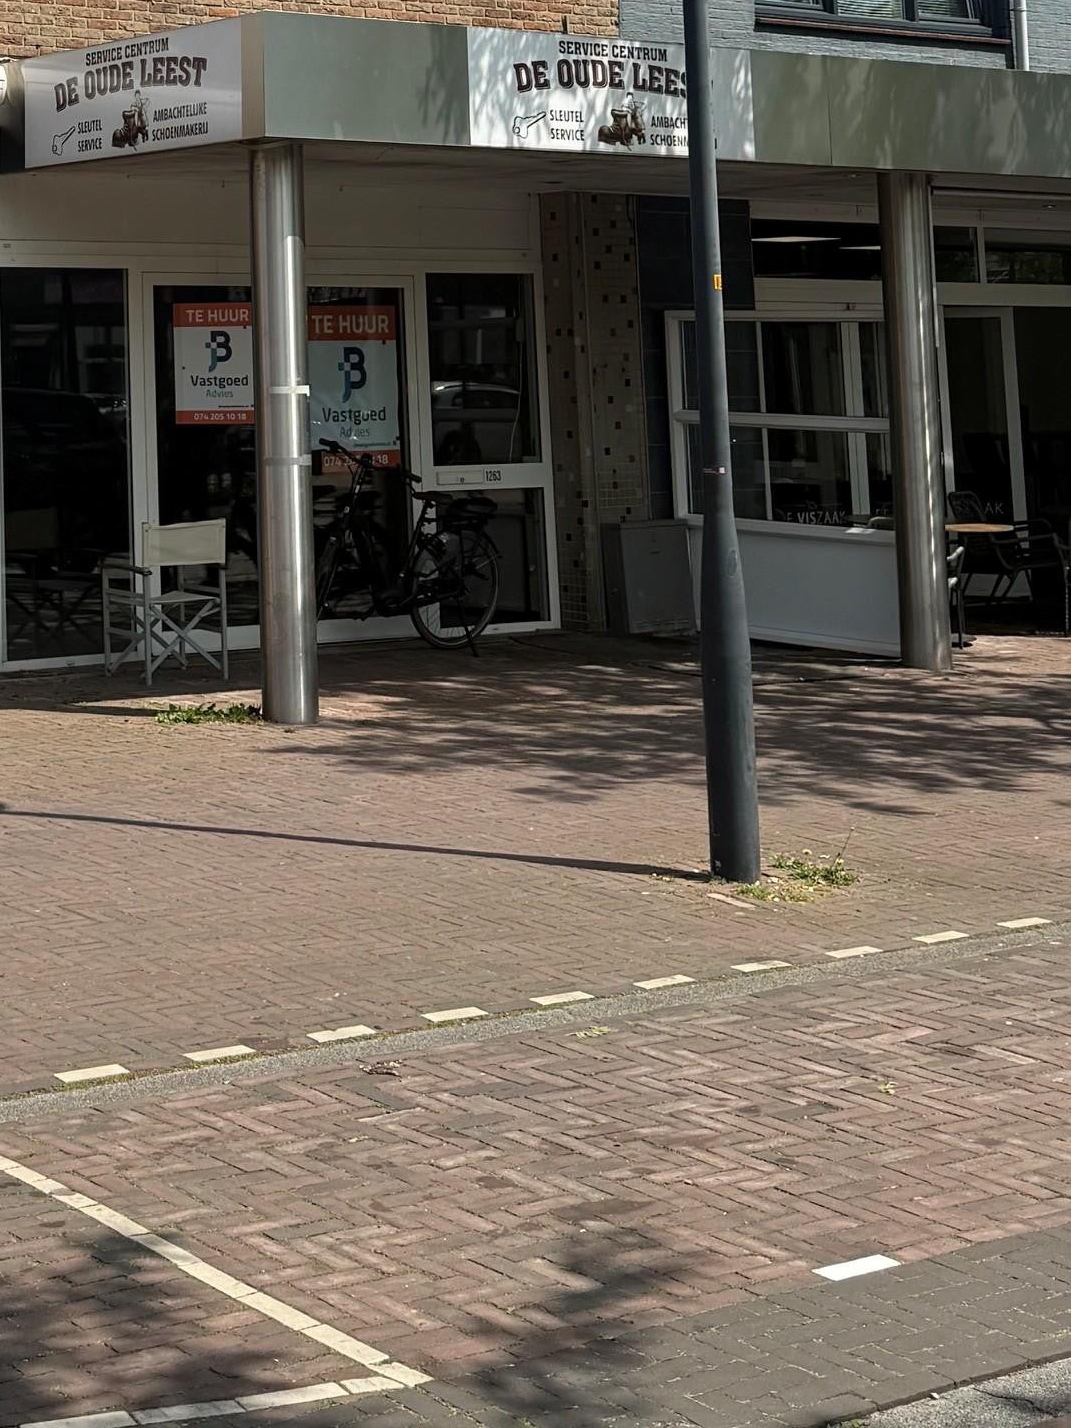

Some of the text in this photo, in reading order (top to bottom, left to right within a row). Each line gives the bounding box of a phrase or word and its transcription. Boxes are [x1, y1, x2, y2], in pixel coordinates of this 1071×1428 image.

[85, 37, 169, 66] SERVICE CENTRUM
[558, 40, 668, 62] SERVICE CENTRUM
[513, 60, 551, 93] DE
[556, 58, 626, 91] OUDE
[54, 56, 208, 112] DE OUDE LEEST
[153, 102, 208, 123] AMBACHTELIJKE
[549, 109, 585, 123] SLEUTEL
[77, 119, 103, 134] SLEUTEL
[152, 121, 209, 141] SCHOENMAKERIJ
[550, 128, 585, 142] SERVICE
[77, 137, 103, 153] SERVICE
[186, 308, 249, 323] TE HUUR
[311, 315, 389, 334] TE HUUR
[190, 375, 249, 388] Vastgoed
[205, 389, 234, 398] Advies
[322, 406, 386, 425] Vastgoed
[323, 456, 342, 467] 074
[485, 470, 502, 481] 1263
